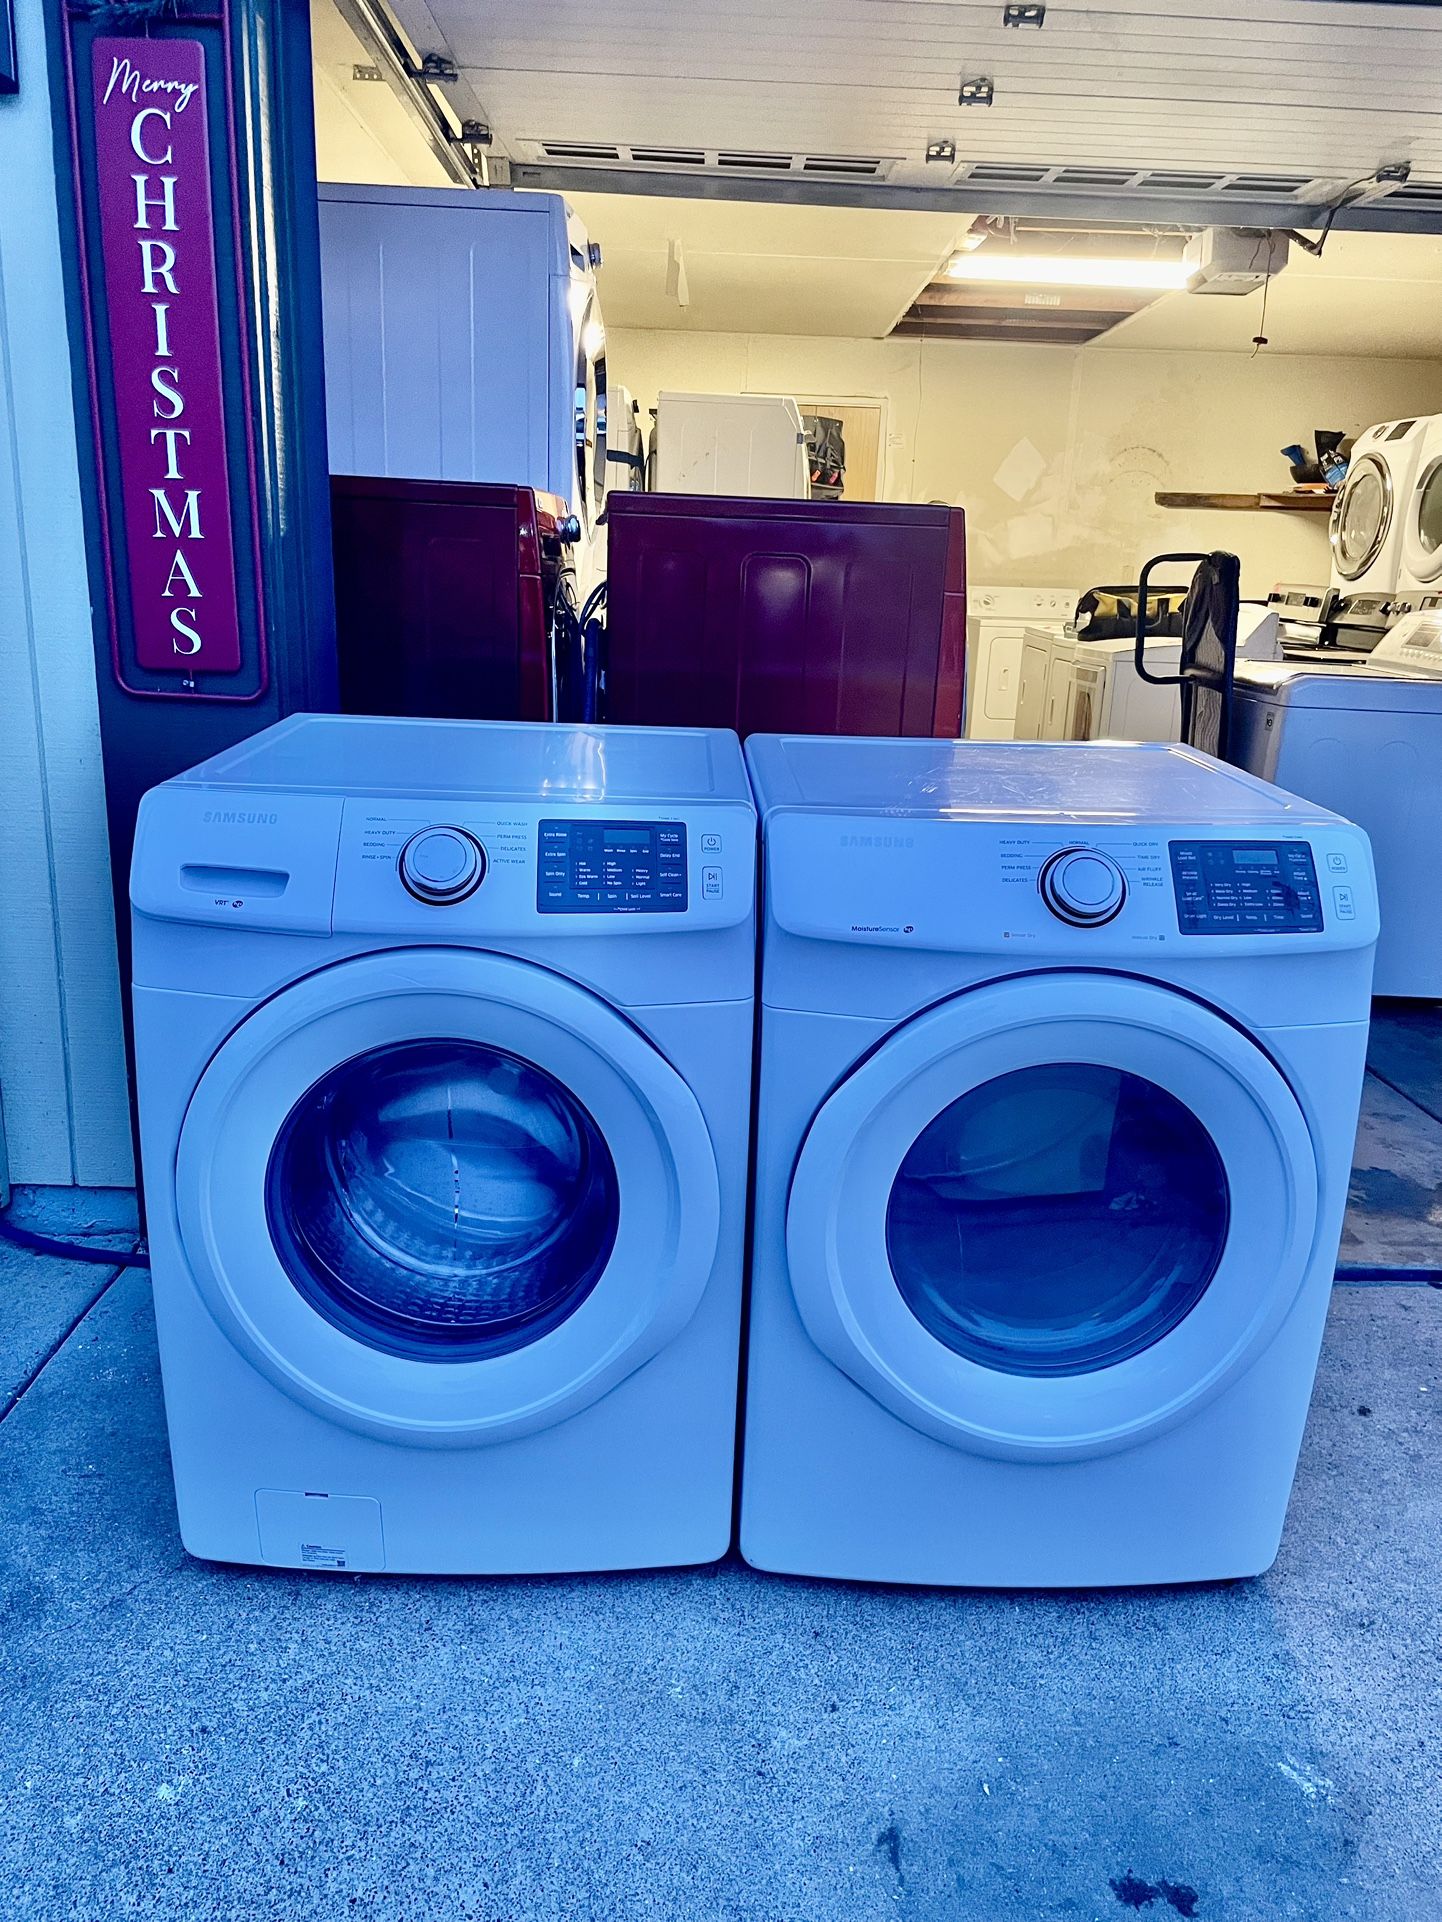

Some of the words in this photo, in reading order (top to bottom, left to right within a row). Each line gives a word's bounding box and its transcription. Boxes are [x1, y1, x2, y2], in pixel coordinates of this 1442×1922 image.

[102, 56, 200, 113] Merry
[129, 107, 205, 656] CHRISTMAS
[203, 811, 278, 825] SAMSUNG
[840, 836, 914, 848] SAMSUNG
